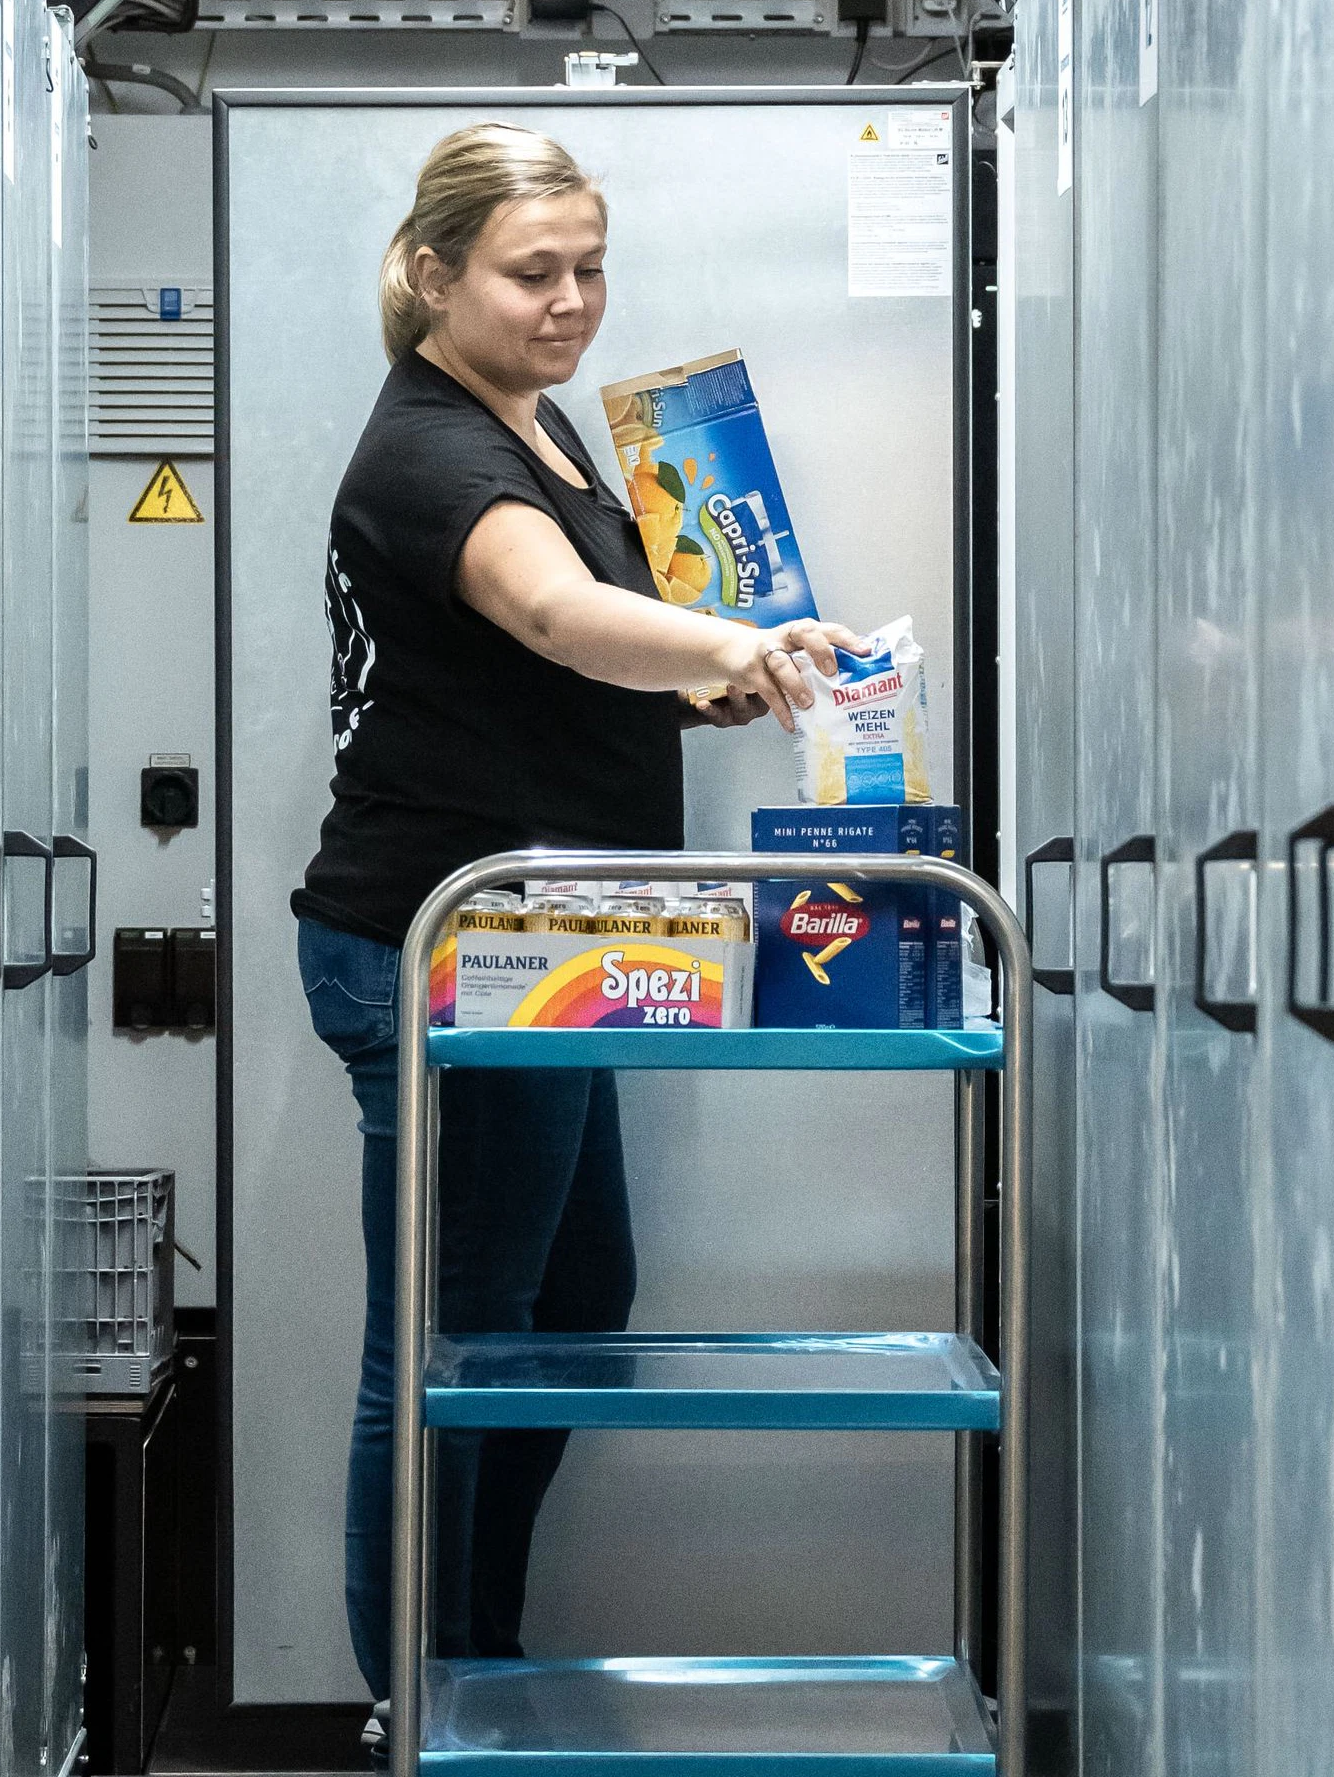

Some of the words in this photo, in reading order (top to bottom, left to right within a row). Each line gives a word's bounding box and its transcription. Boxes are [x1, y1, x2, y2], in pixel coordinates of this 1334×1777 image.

[707, 493, 760, 608] Capri-Sun
[832, 672, 903, 707] Diamant
[848, 709, 895, 721] WEIZEN
[855, 722, 890, 732] MEHL
[774, 827, 796, 836] MINI
[800, 827, 833, 836] PENNE
[838, 826, 874, 836] RIGATE
[790, 912, 859, 934] Barilla
[461, 954, 549, 970] PAULANER
[601, 951, 701, 1008] Spezi
[643, 1006, 691, 1025] zero
